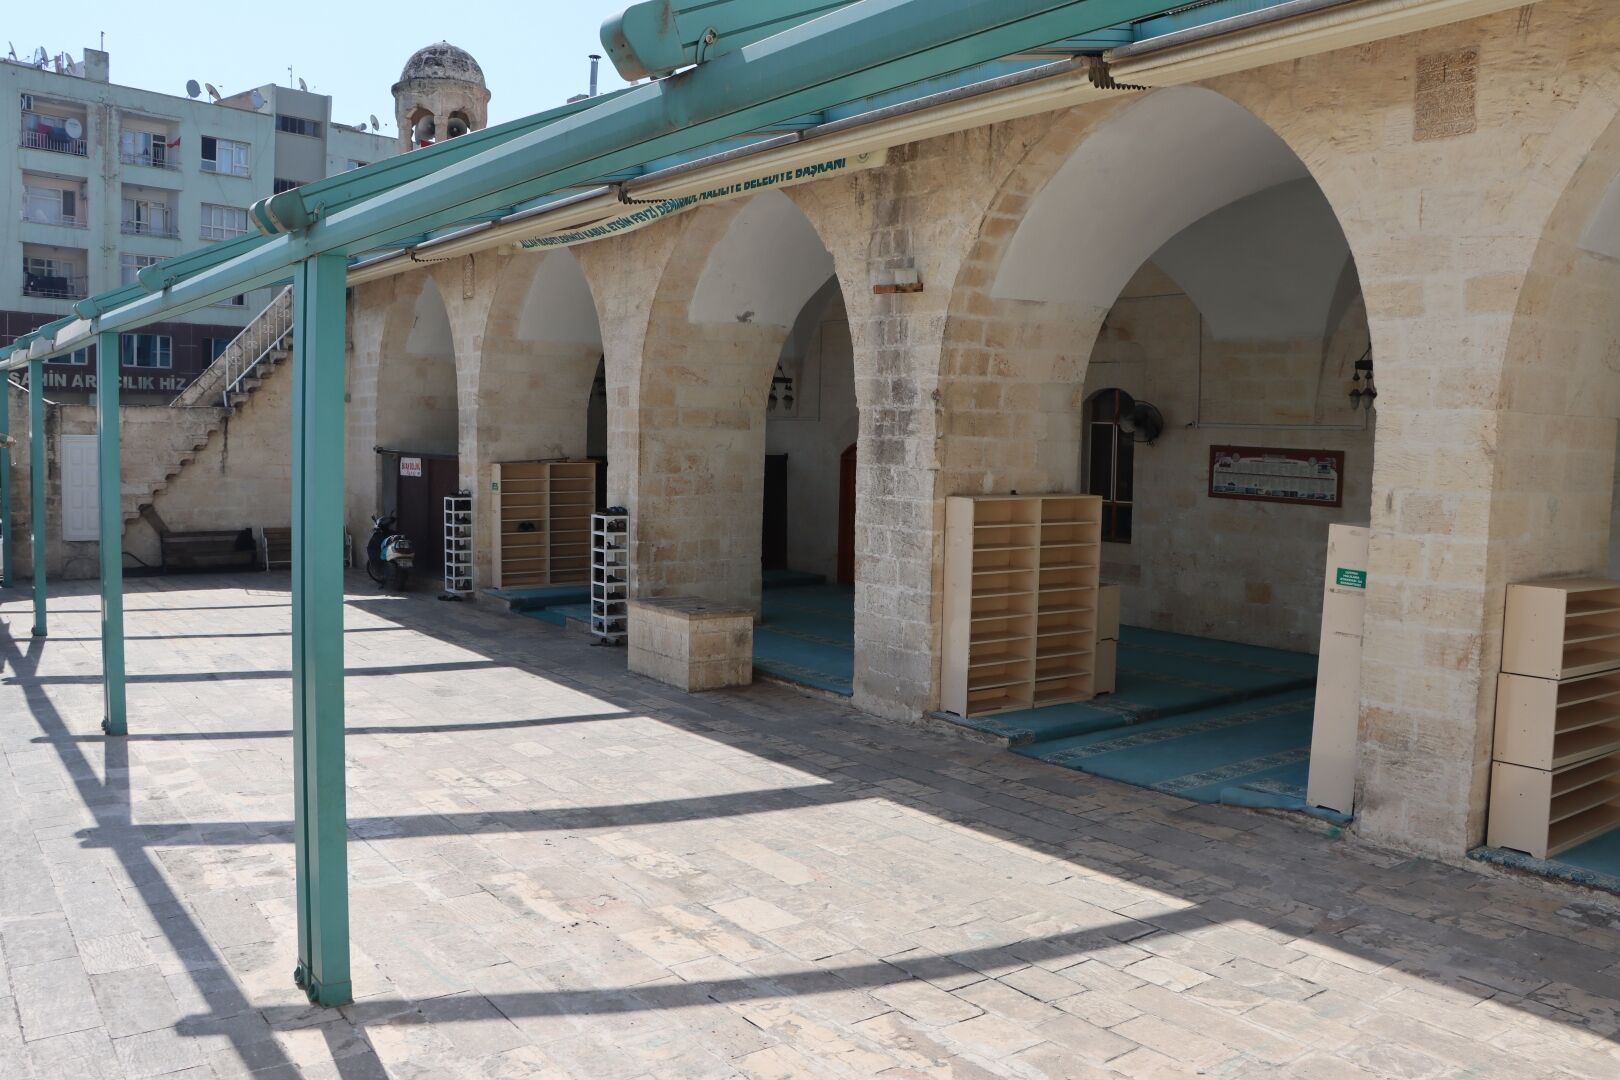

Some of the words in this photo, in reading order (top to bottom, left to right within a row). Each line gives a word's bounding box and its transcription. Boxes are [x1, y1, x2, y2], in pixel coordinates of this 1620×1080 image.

[583, 224, 611, 240] KABUL
[607, 216, 635, 232] ETSİN
[630, 205, 659, 224] FEVZİ
[71, 374, 154, 390] ARILIK
